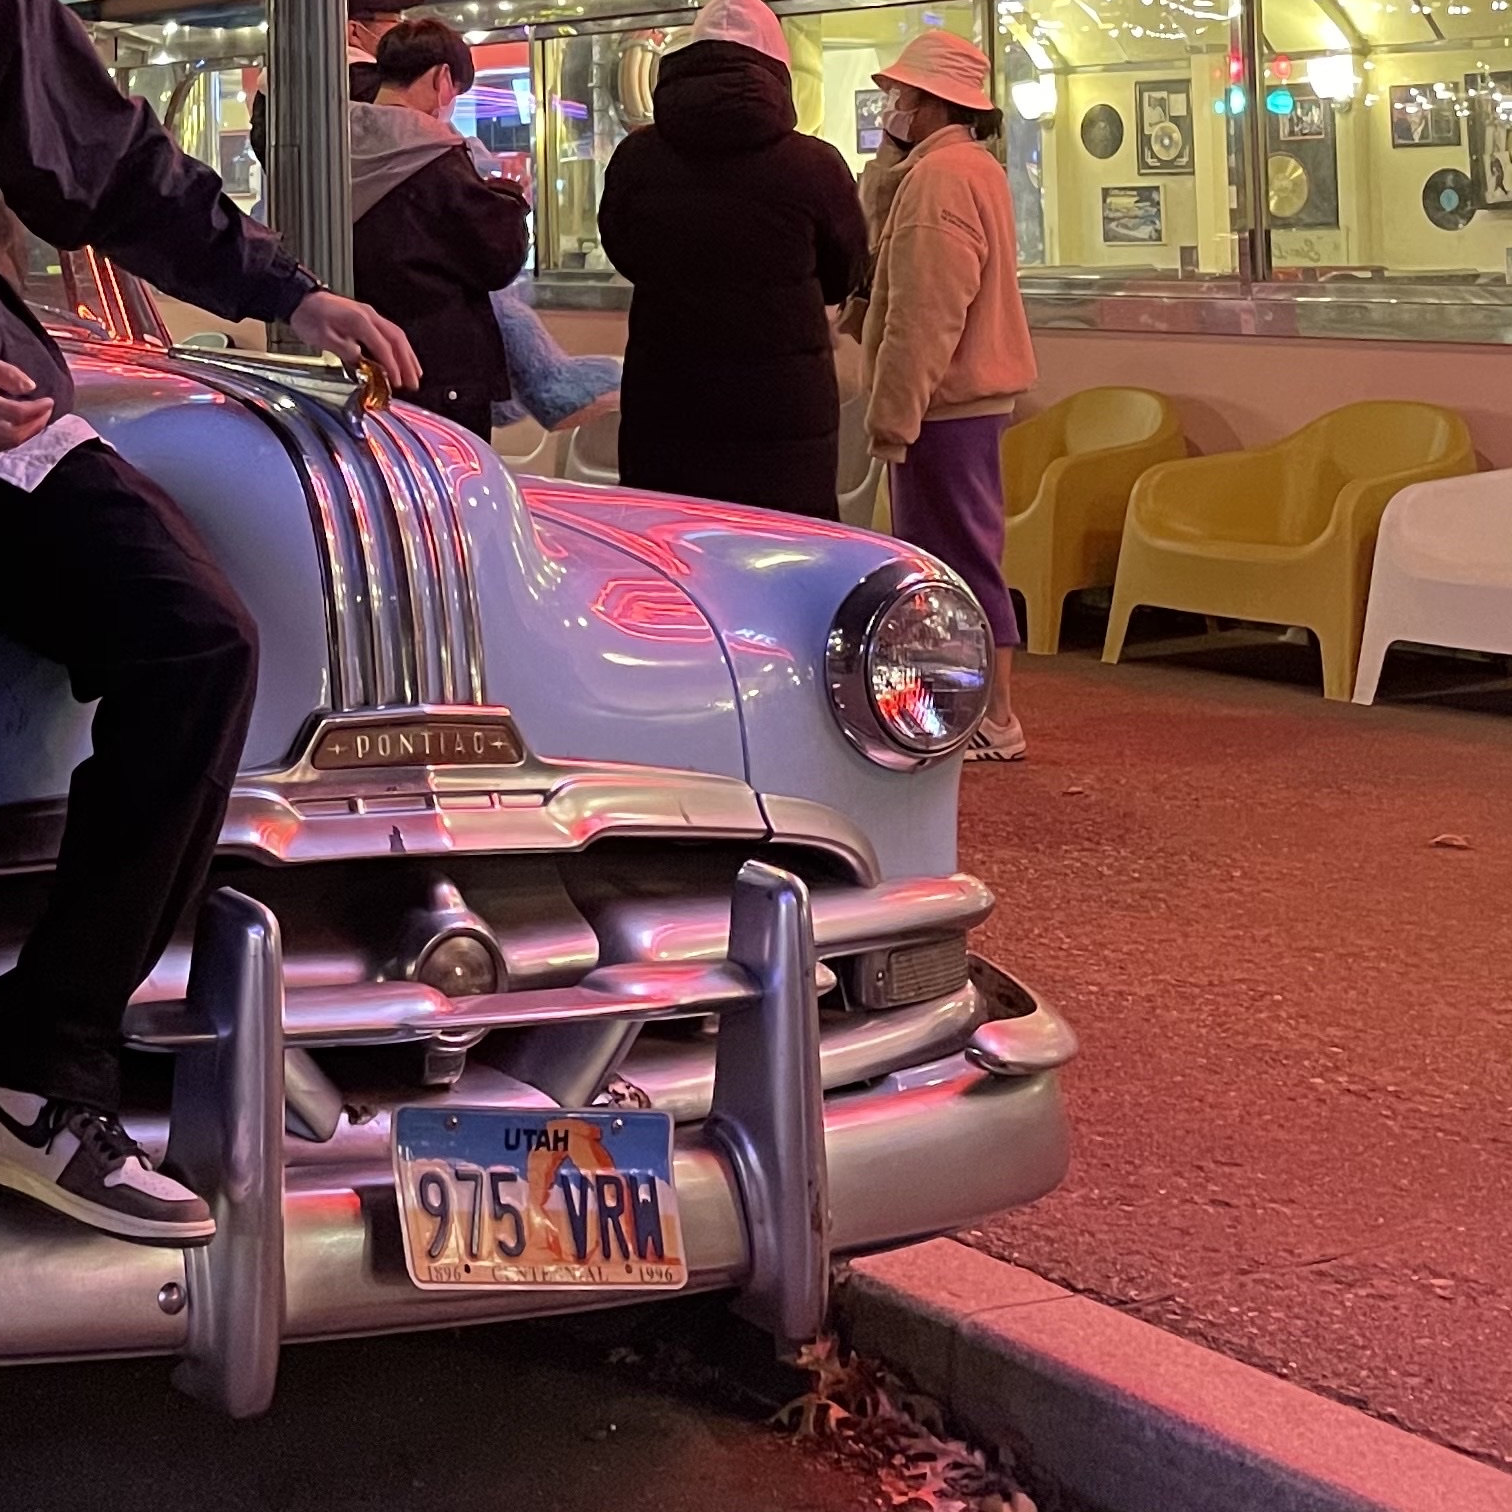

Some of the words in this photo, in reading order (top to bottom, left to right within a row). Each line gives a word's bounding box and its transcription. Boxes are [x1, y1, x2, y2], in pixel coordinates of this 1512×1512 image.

[355, 731, 484, 758] PONTIAC
[504, 1127, 570, 1152] UTAH
[419, 1167, 527, 1259] 975
[560, 1173, 665, 1261] VRW
[427, 1265, 462, 1282] 1896
[639, 1266, 673, 1282] 1996
